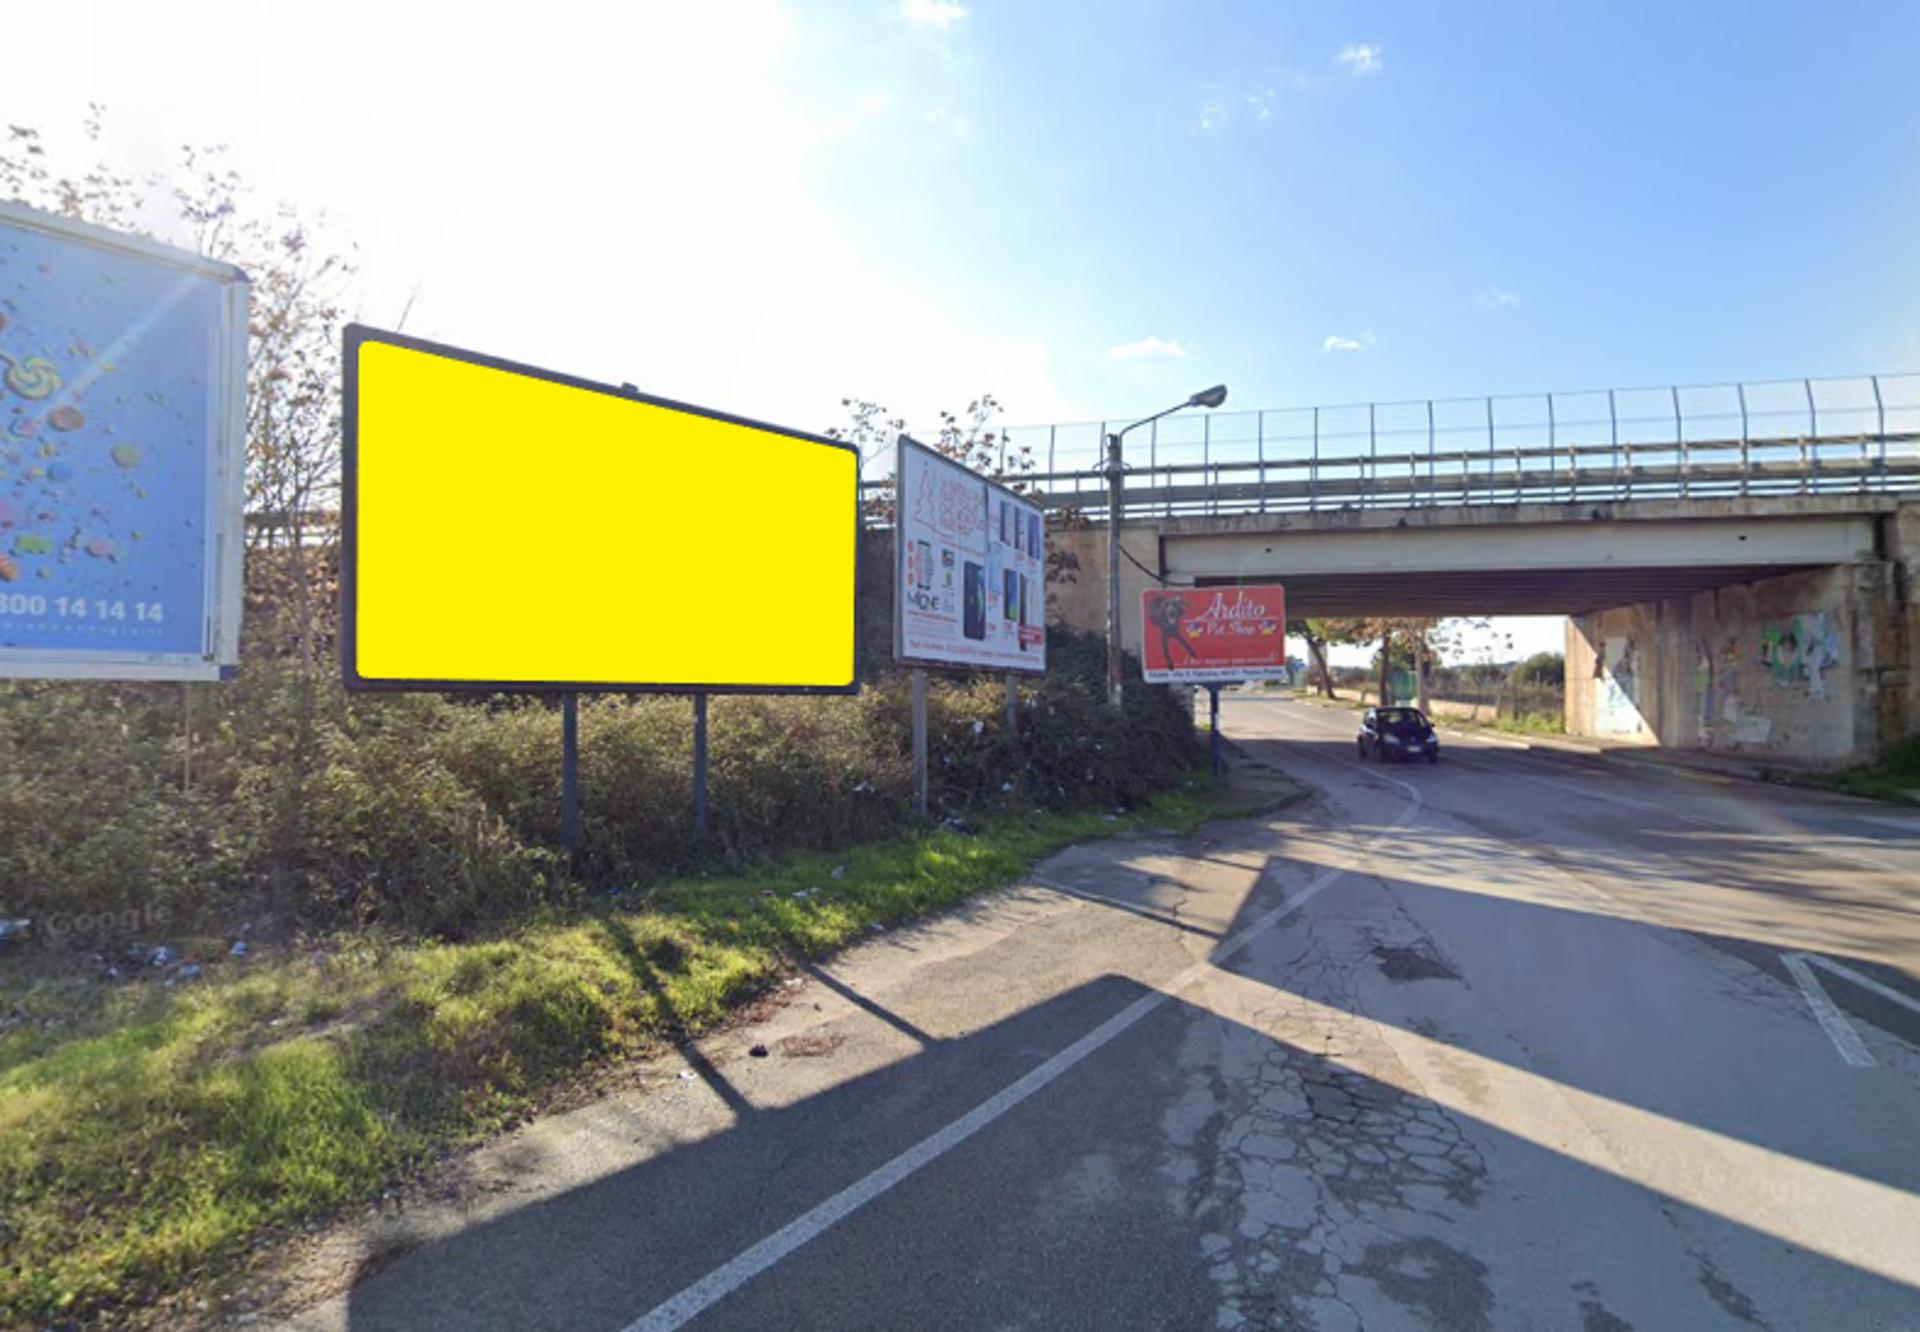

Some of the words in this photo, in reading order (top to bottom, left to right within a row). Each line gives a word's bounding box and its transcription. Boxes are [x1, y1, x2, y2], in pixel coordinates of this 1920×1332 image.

[56, 597, 87, 618] 14
[96, 600, 126, 621] 14
[135, 601, 163, 623] 14
[1195, 590, 1265, 620] Ardito
